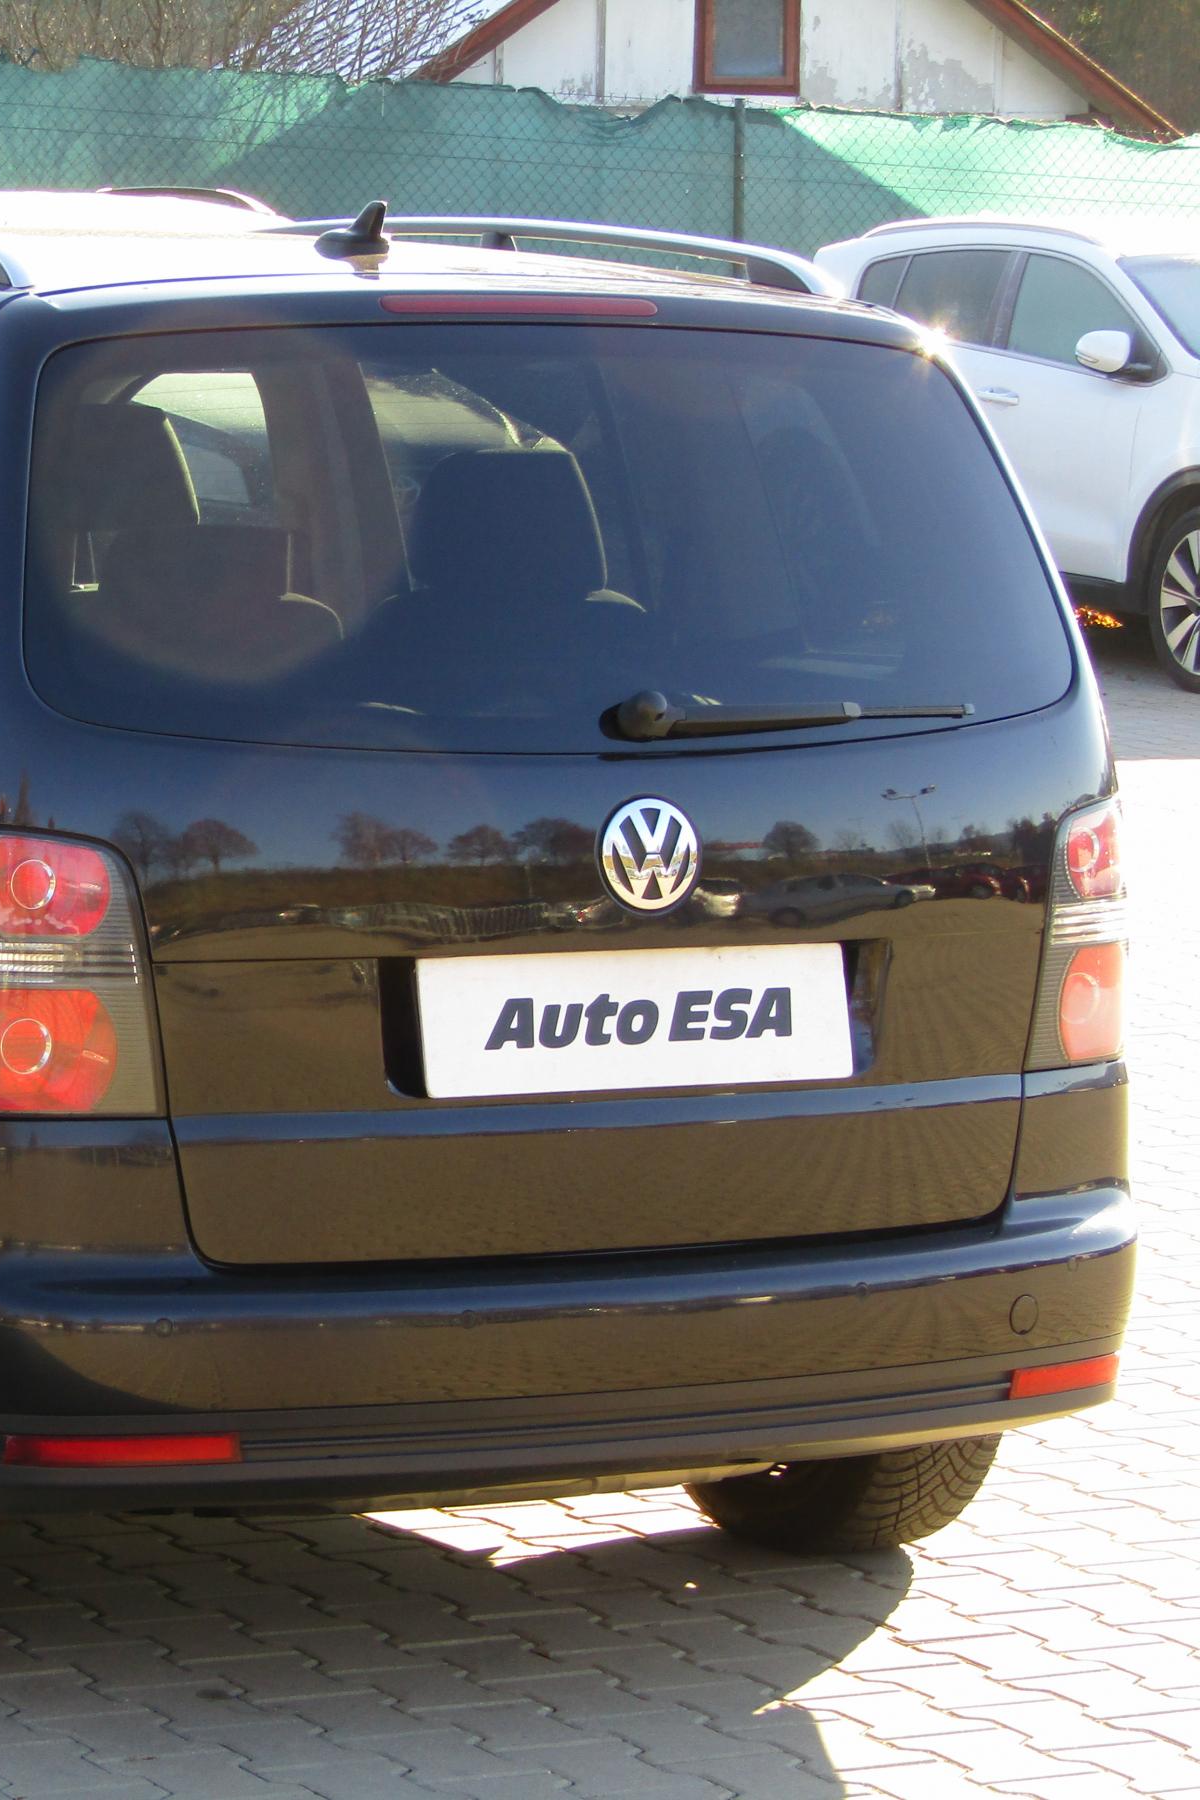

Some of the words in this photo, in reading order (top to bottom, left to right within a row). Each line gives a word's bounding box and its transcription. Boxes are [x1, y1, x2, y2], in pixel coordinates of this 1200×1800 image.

[604, 799, 697, 909] VW
[484, 992, 660, 1051] Auto
[668, 986, 793, 1042] ESA
